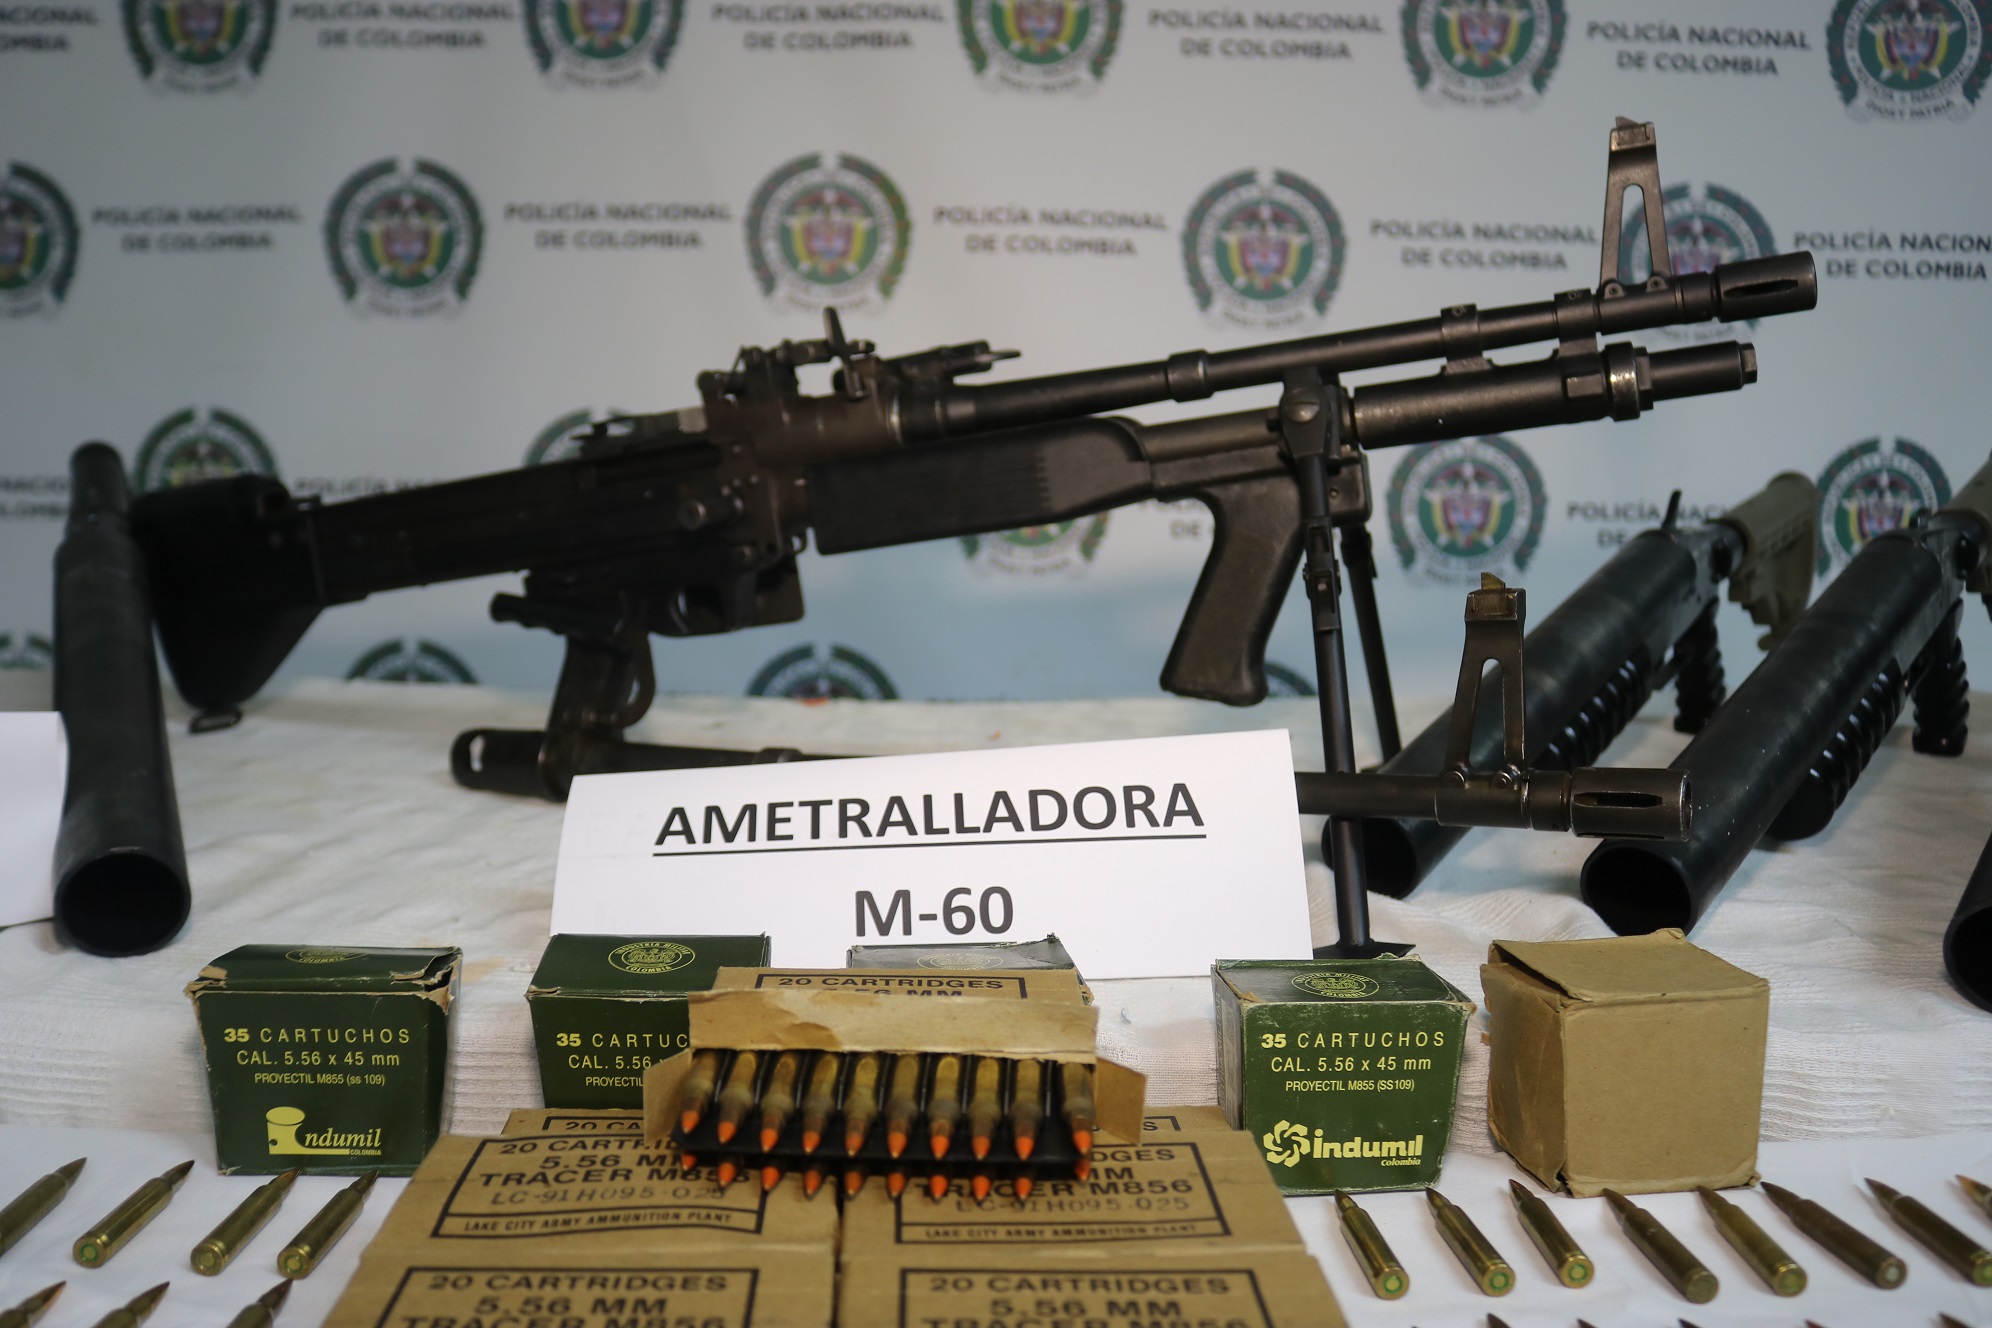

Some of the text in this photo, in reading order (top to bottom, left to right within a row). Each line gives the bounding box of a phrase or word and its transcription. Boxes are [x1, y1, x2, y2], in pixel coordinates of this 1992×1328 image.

[816, 3, 947, 23] NACIONAL
[1149, 7, 1384, 34] POLICÍA NACIONAL
[318, 28, 486, 48] DE COLOMBIA
[743, 30, 914, 49] DE COLOMBIA
[1588, 19, 1813, 51] POLICÍA NACIONAL
[1180, 36, 1353, 60] DE COLOMBIA
[1616, 49, 1779, 77] DE COLOMBIA
[605, 202, 735, 222] NACIONAL
[1038, 208, 1168, 231] NACIONAL
[535, 229, 703, 250] DE COLOMBIA
[1370, 216, 1599, 245] POLICÍA NACIONAL
[1793, 228, 1893, 250] POLICÍA
[121, 231, 273, 253] DE COLOMBIA
[965, 233, 1137, 256] DE COLOMBIA
[1401, 248, 1568, 270] DE COLOMBIA
[1826, 258, 1988, 281] DE COLOMBIA
[1567, 499, 1660, 521] POLICÍA
[1169, 520, 1201, 541] DE
[656, 782, 1205, 847] AMETRALLADORA
[854, 885, 1014, 939] M-60
[778, 977, 1004, 989] 20 CARTRIDGES
[224, 1028, 410, 1044] 35 CARTUCHOS
[556, 1033, 689, 1048] 35 CARTUC
[1261, 1031, 1445, 1049] 35 CARTUCHOS
[237, 1050, 400, 1066] CAL. 5.56 x 45 mm
[568, 1054, 652, 1069] CAL. 5.56
[1271, 1057, 1431, 1073] CAL. 5.56 x 45 mm
[254, 1073, 315, 1085] PROYECTIL
[316, 1073, 344, 1085] M855
[585, 1076, 644, 1087] PROYECTIL
[1285, 1080, 1345, 1092] PROYECTIL
[1347, 1080, 1375, 1092] M855
[350, 1148, 382, 1156] COLOMBIA
[500, 1142, 537, 1155] 20
[1312, 1128, 1424, 1160] indumil
[540, 1154, 620, 1170] 5.56
[1381, 1157, 1421, 1167] colombia
[480, 1168, 634, 1187] TRACER
[1089, 1179, 1193, 1195] M856
[464, 1211, 733, 1232] LAKE CITY ARMY AMMUNITION PLANT
[926, 1228, 960, 1239] LAKE
[967, 1227, 999, 1239] CITY
[1004, 1226, 1046, 1238] ARMY
[429, 1274, 729, 1292] 20 CARTRIDGES
[929, 1276, 1231, 1295] 20 CARTRIDGES
[474, 1297, 668, 1316] 5.56 MM
[990, 1299, 1182, 1319] 5.56 MM
[401, 1315, 586, 1328] TRACER
